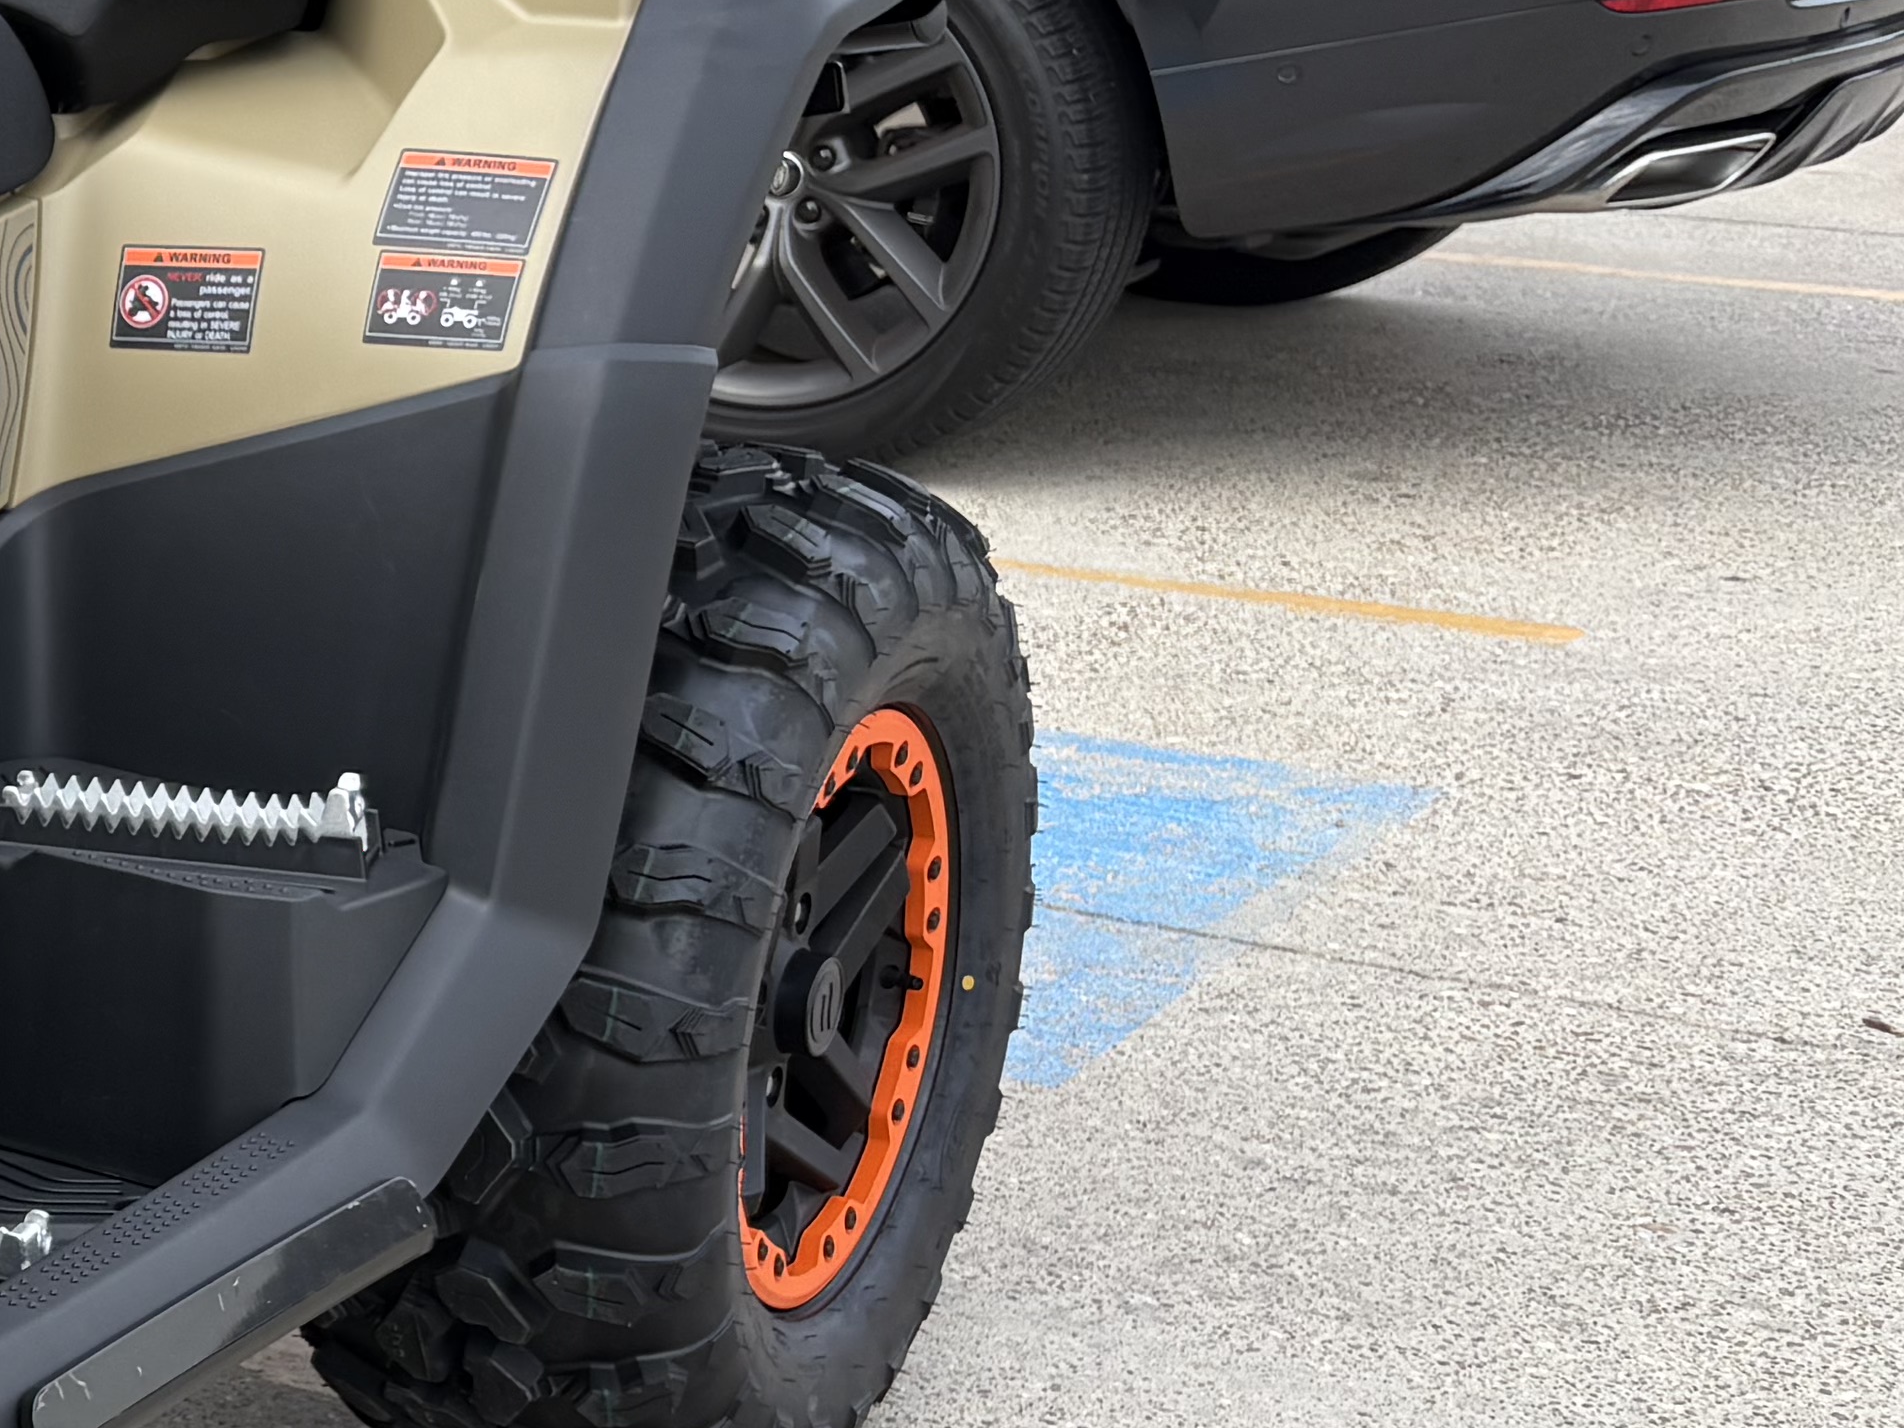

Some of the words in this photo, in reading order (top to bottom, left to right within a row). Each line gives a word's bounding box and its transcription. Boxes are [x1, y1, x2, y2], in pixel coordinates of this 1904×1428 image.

[451, 157, 518, 172] WARNING
[168, 252, 232, 265] WARNING
[427, 257, 488, 271] WARNING
[205, 273, 227, 284] ride
[230, 275, 243, 284] as
[247, 274, 254, 284] a
